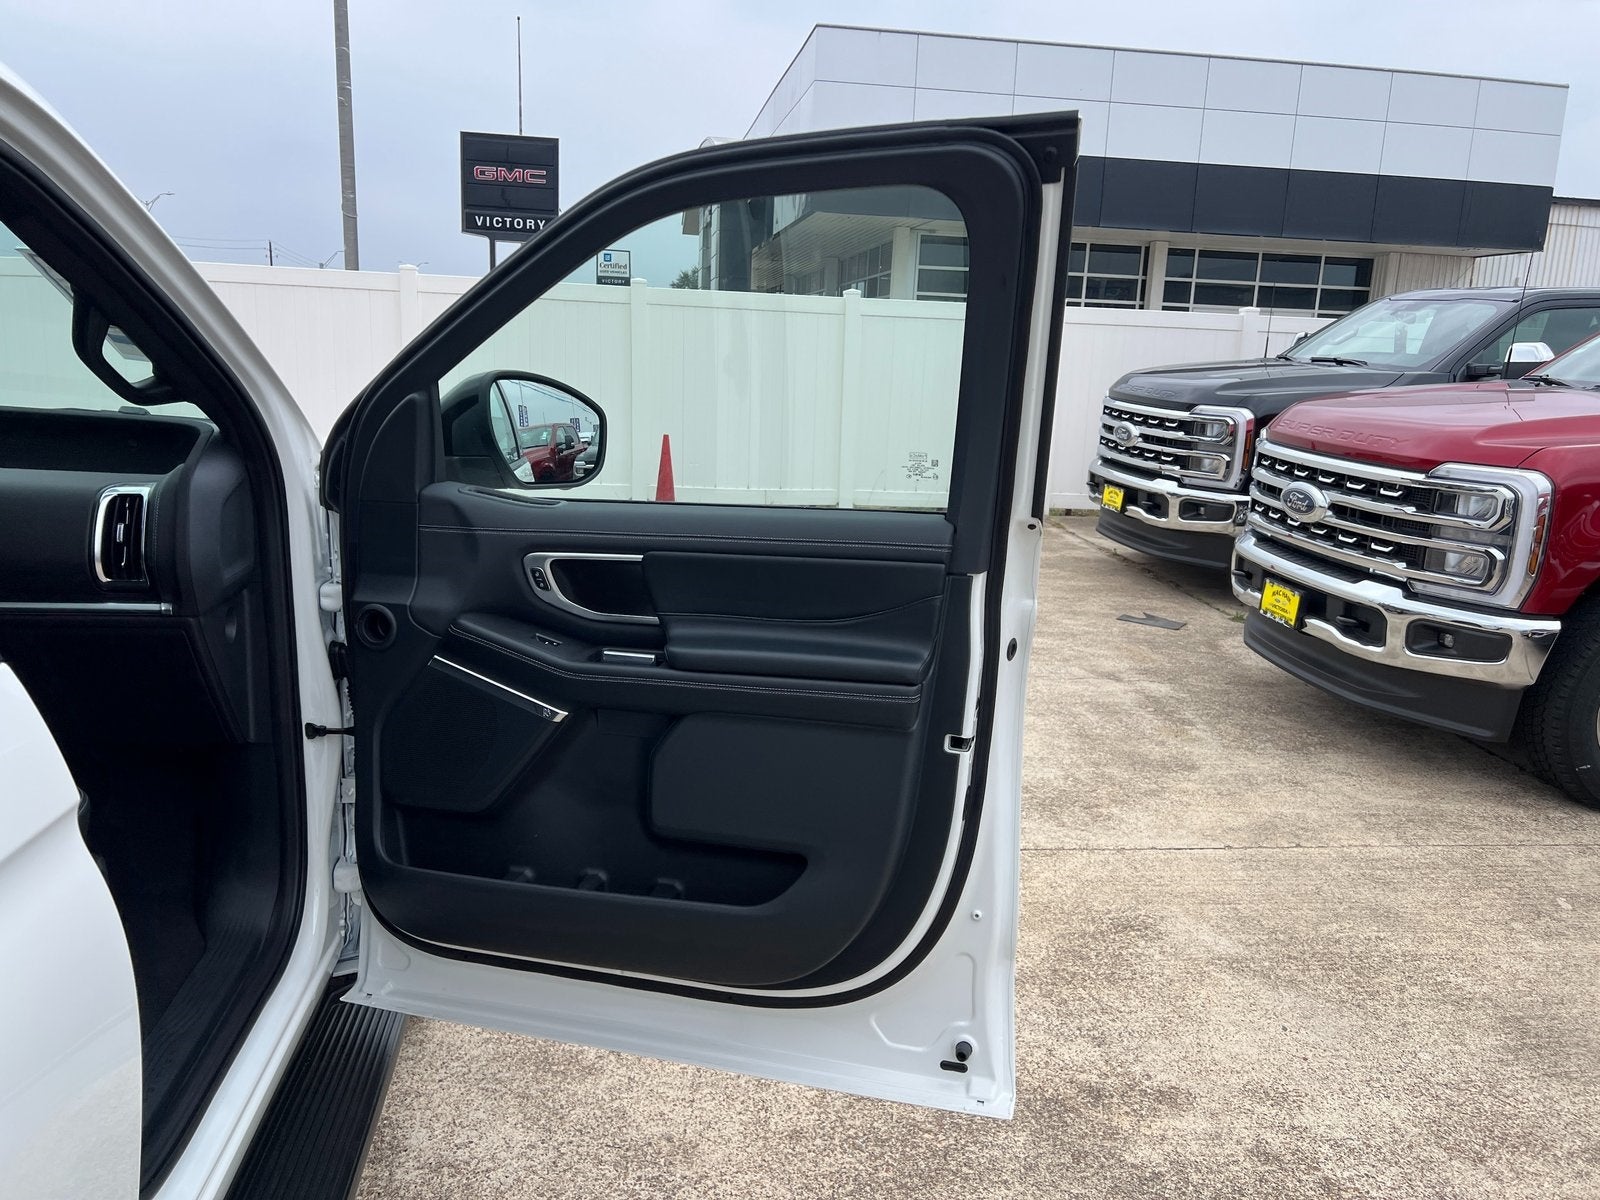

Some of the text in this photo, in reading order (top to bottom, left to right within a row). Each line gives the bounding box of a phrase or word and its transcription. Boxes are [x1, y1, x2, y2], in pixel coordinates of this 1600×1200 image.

[473, 165, 547, 184] GMC
[474, 215, 546, 230] VICTORY
[599, 262, 628, 270] Certified
[1276, 418, 1409, 449] SUPER DUTY
[1286, 491, 1308, 512] Ford
